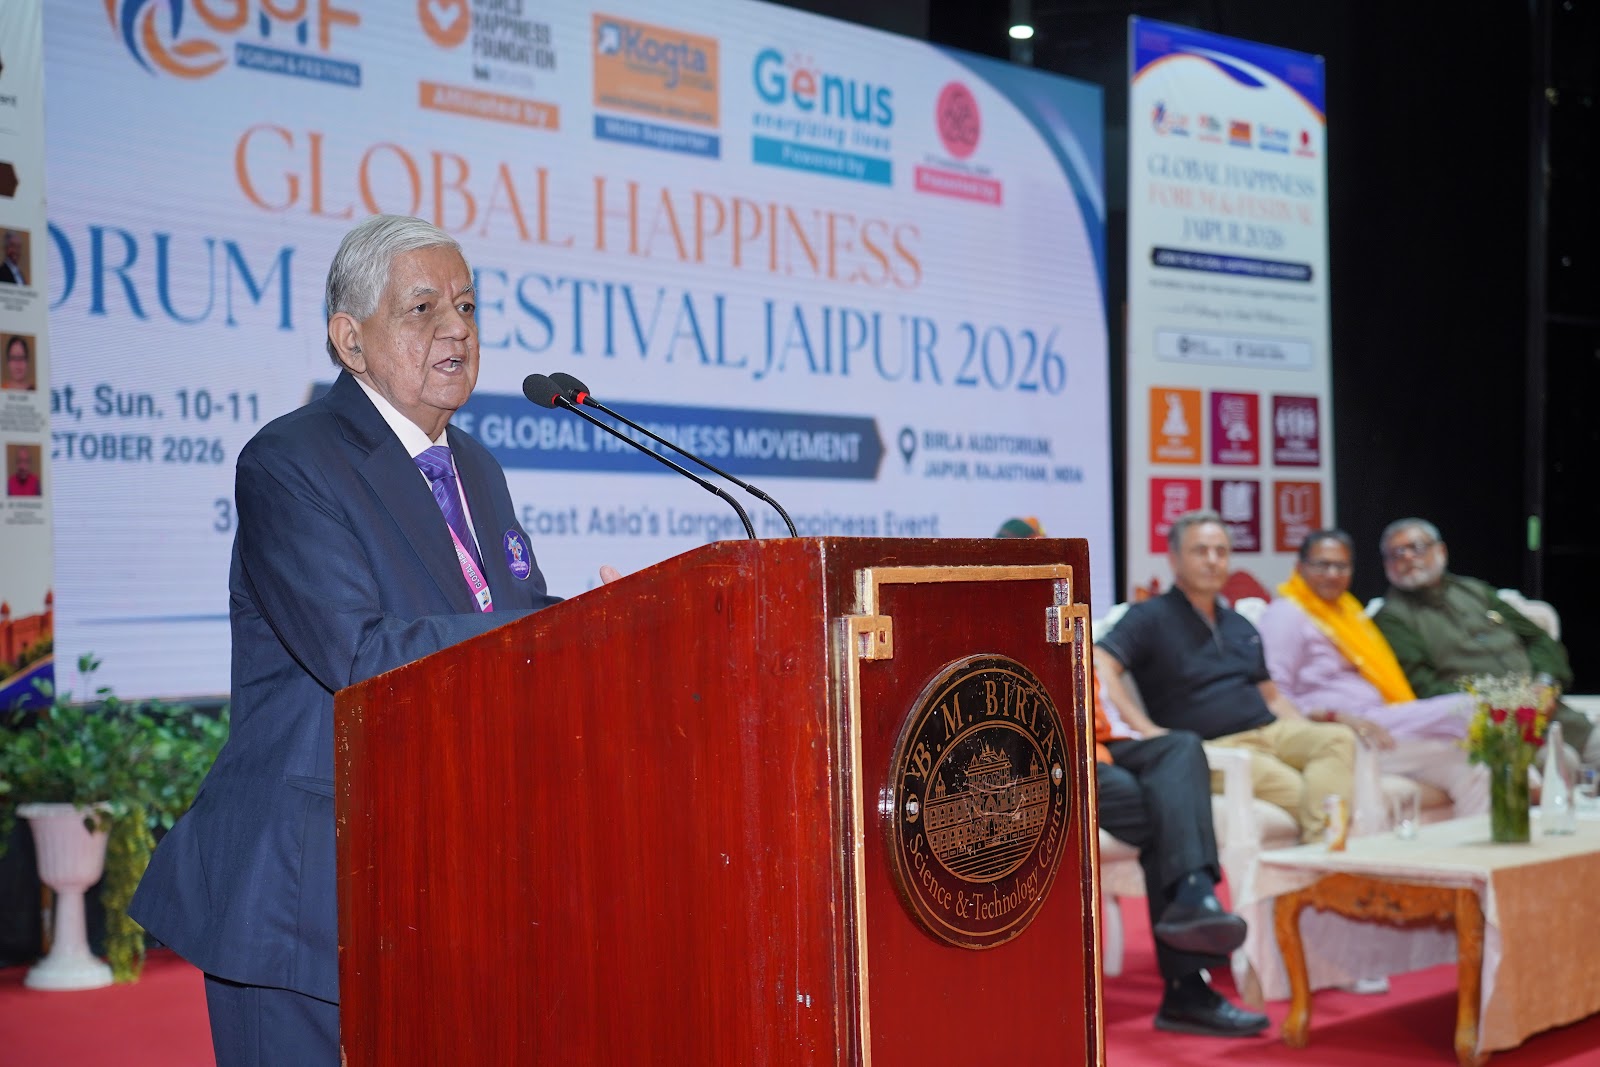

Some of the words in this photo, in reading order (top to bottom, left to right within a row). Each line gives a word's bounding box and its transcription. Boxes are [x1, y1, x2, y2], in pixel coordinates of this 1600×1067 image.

[472, 13, 551, 44] HAPPINESS
[472, 32, 556, 70] FOUNDATION
[623, 25, 708, 89] Kogta
[753, 48, 893, 127] Genus
[782, 144, 842, 171] Powered
[845, 151, 867, 178] by
[233, 124, 573, 248] GLOBAL
[594, 175, 923, 290] HAPPINESS
[474, 267, 747, 370] ESTIVAL
[753, 298, 943, 384] JAIPUR
[954, 321, 1068, 396] 2026
[51, 384, 82, 421] at,
[94, 383, 163, 418] Sun.
[176, 388, 260, 422] 10-11
[162, 435, 225, 465] 2026
[479, 413, 589, 452] GLOBAL
[733, 427, 862, 463] MOVEMENT
[922, 430, 963, 451] BIRLA
[522, 506, 578, 535] East
[587, 505, 661, 537] Asia's
[883, 511, 940, 537] Event
[465, 563, 482, 589] GLOBAL
[940, 691, 973, 741] M.
[984, 680, 1055, 764] BIRLA
[909, 833, 952, 910] Science
[955, 890, 969, 919] &
[972, 866, 1039, 920] Technology
[1038, 790, 1063, 869] Centre
